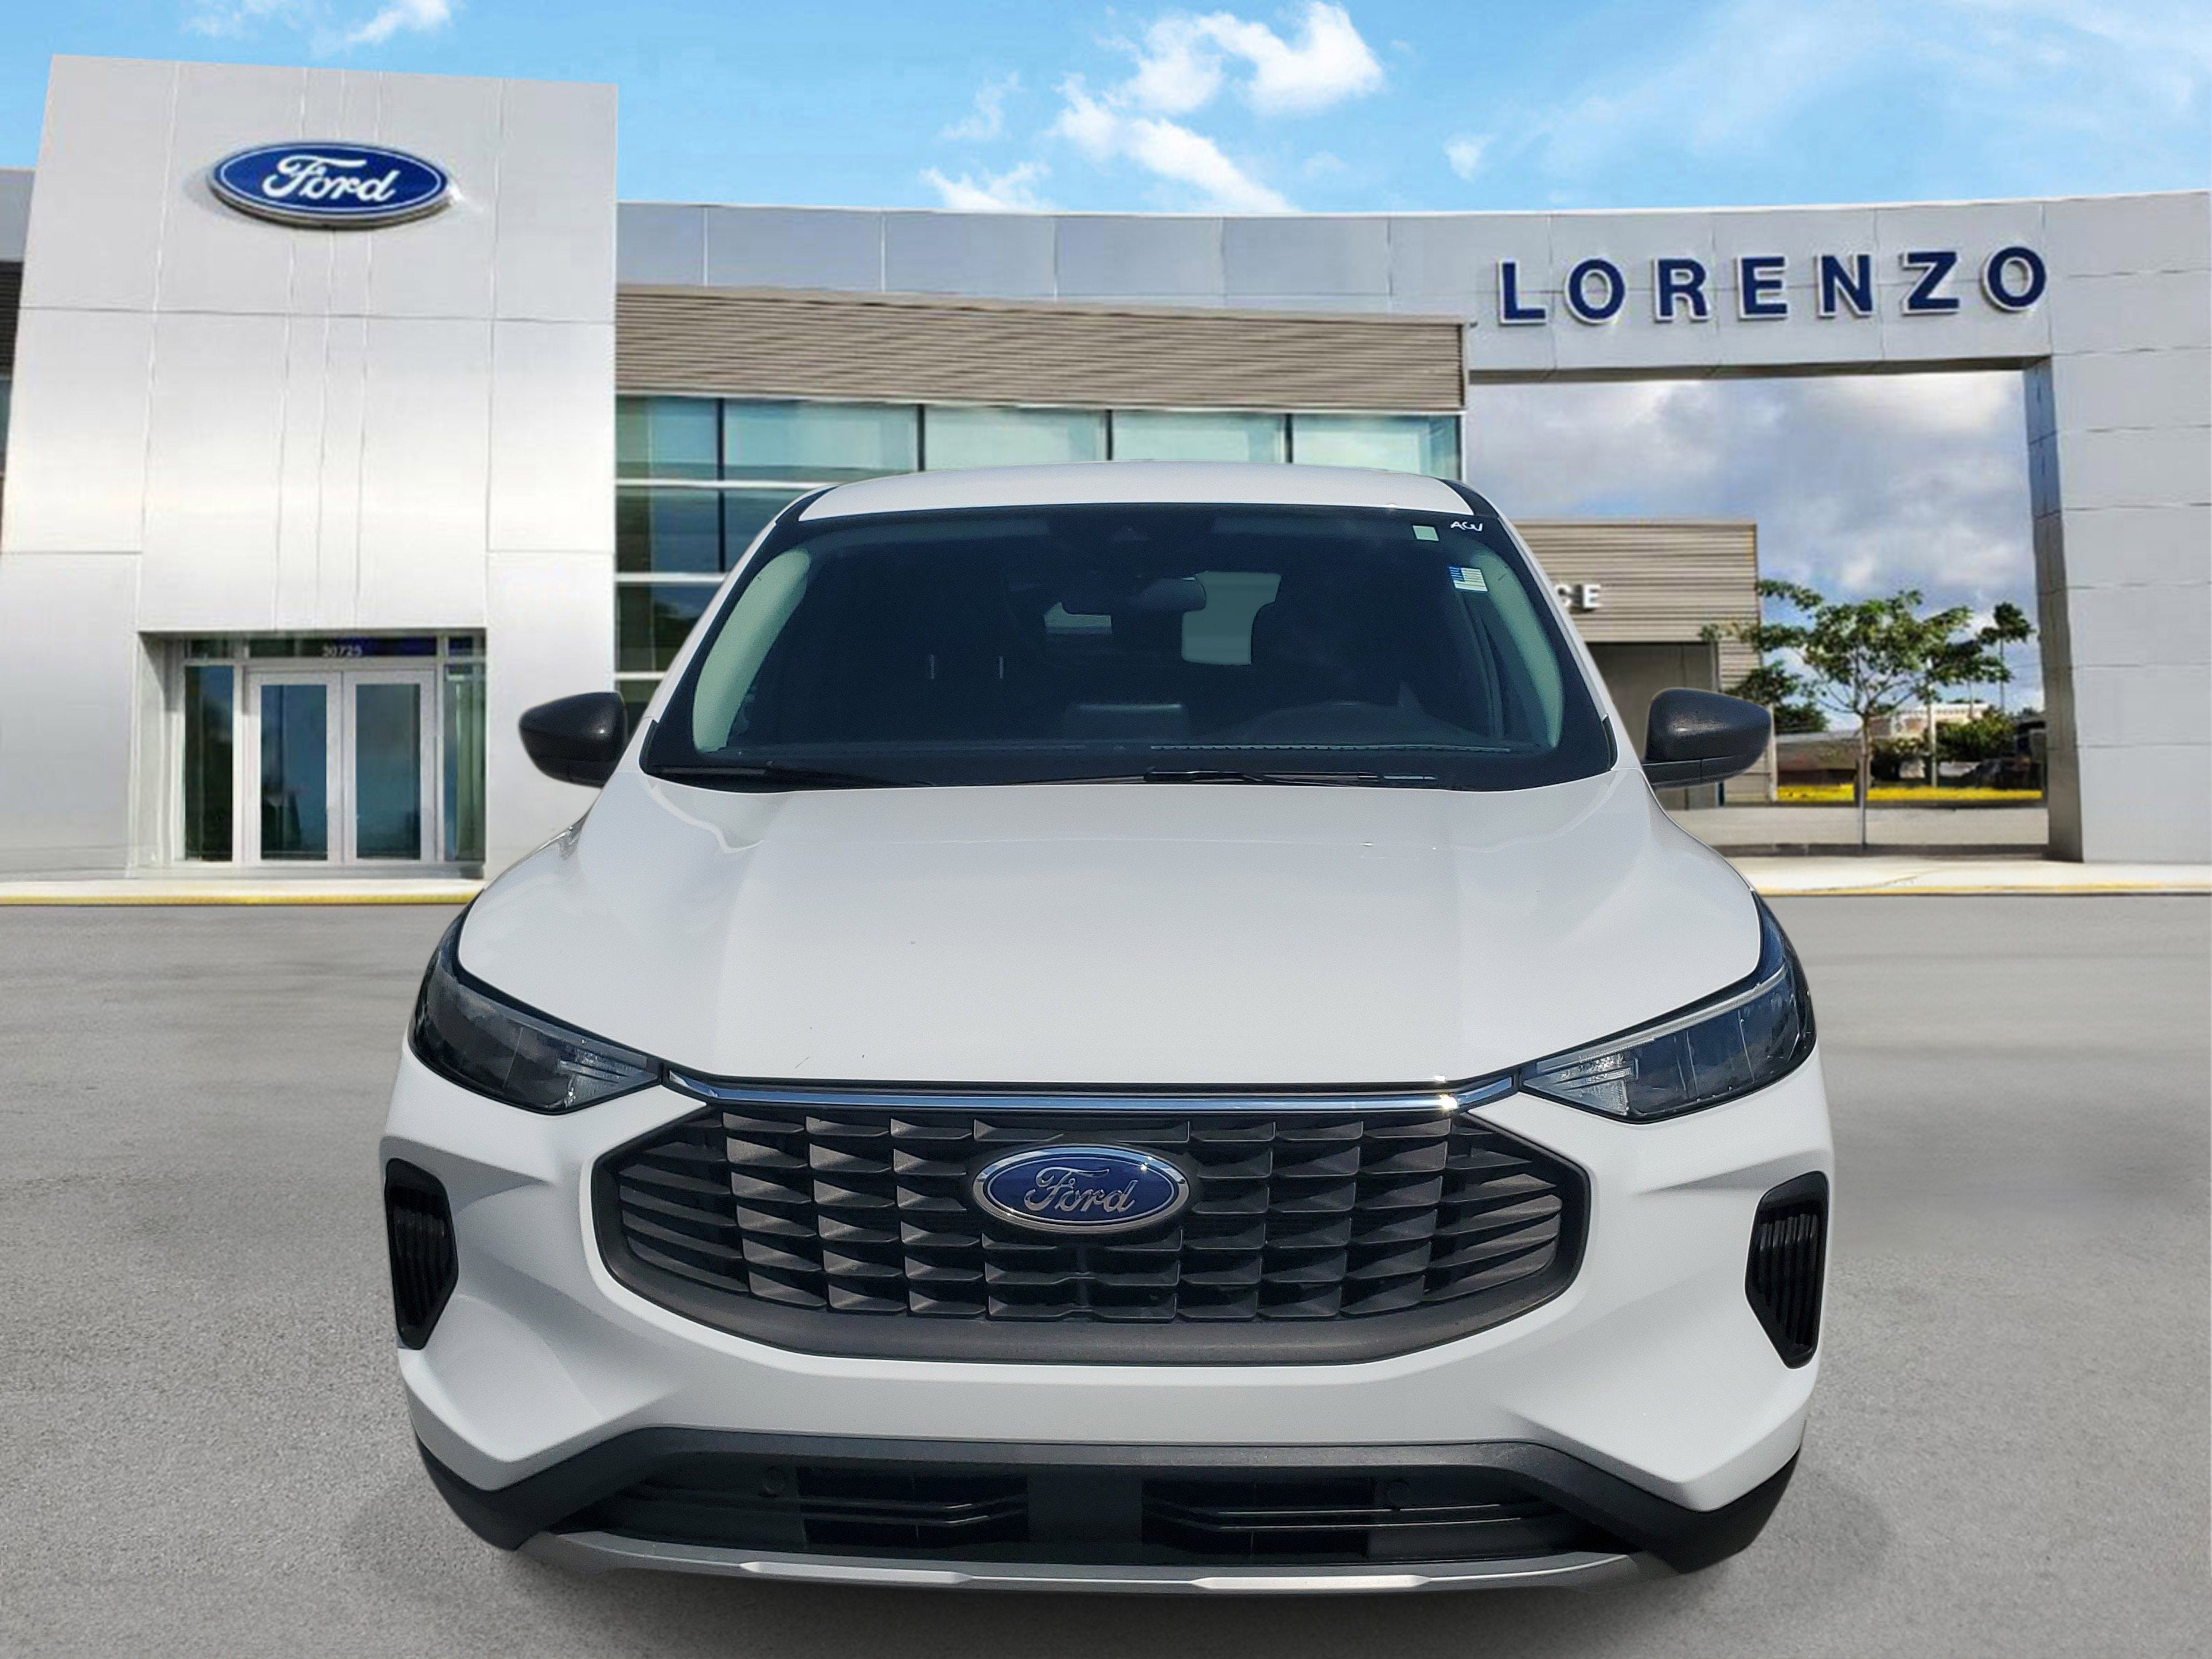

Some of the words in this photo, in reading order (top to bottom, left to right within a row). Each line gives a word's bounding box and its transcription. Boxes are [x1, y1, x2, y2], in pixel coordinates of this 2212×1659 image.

[262, 154, 400, 202] Ford
[1499, 247, 2047, 325] LORENZO
[1024, 1166, 1138, 1213] Ford
